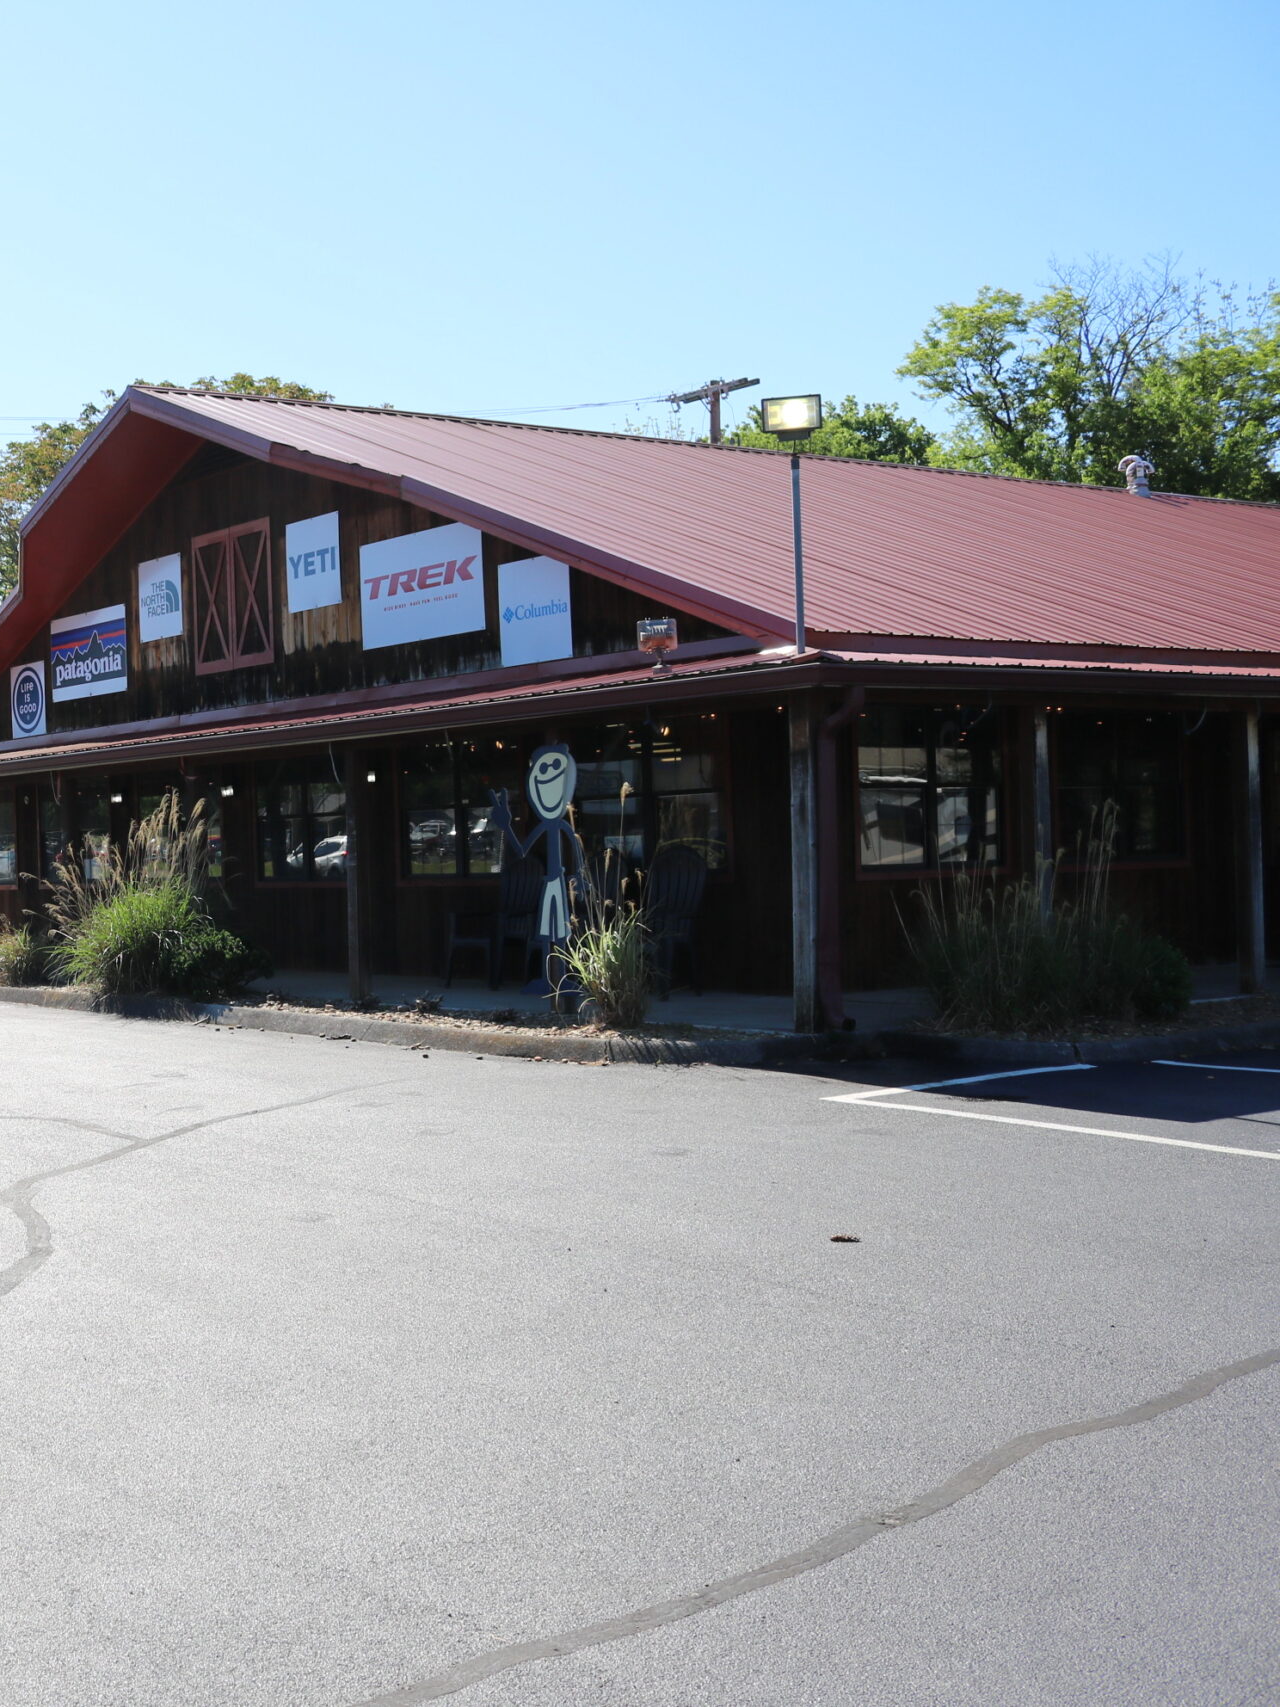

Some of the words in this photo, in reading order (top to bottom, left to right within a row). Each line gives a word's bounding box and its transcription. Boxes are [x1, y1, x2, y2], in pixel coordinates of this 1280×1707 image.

[288, 546, 336, 580] YETI
[363, 554, 478, 600] TREK
[151, 580, 165, 594] THE
[141, 591, 166, 608] NORTH
[147, 605, 166, 618] FACE
[515, 599, 568, 620] Columbia
[56, 651, 122, 686] patagonia
[19, 703, 37, 714] GOOD
